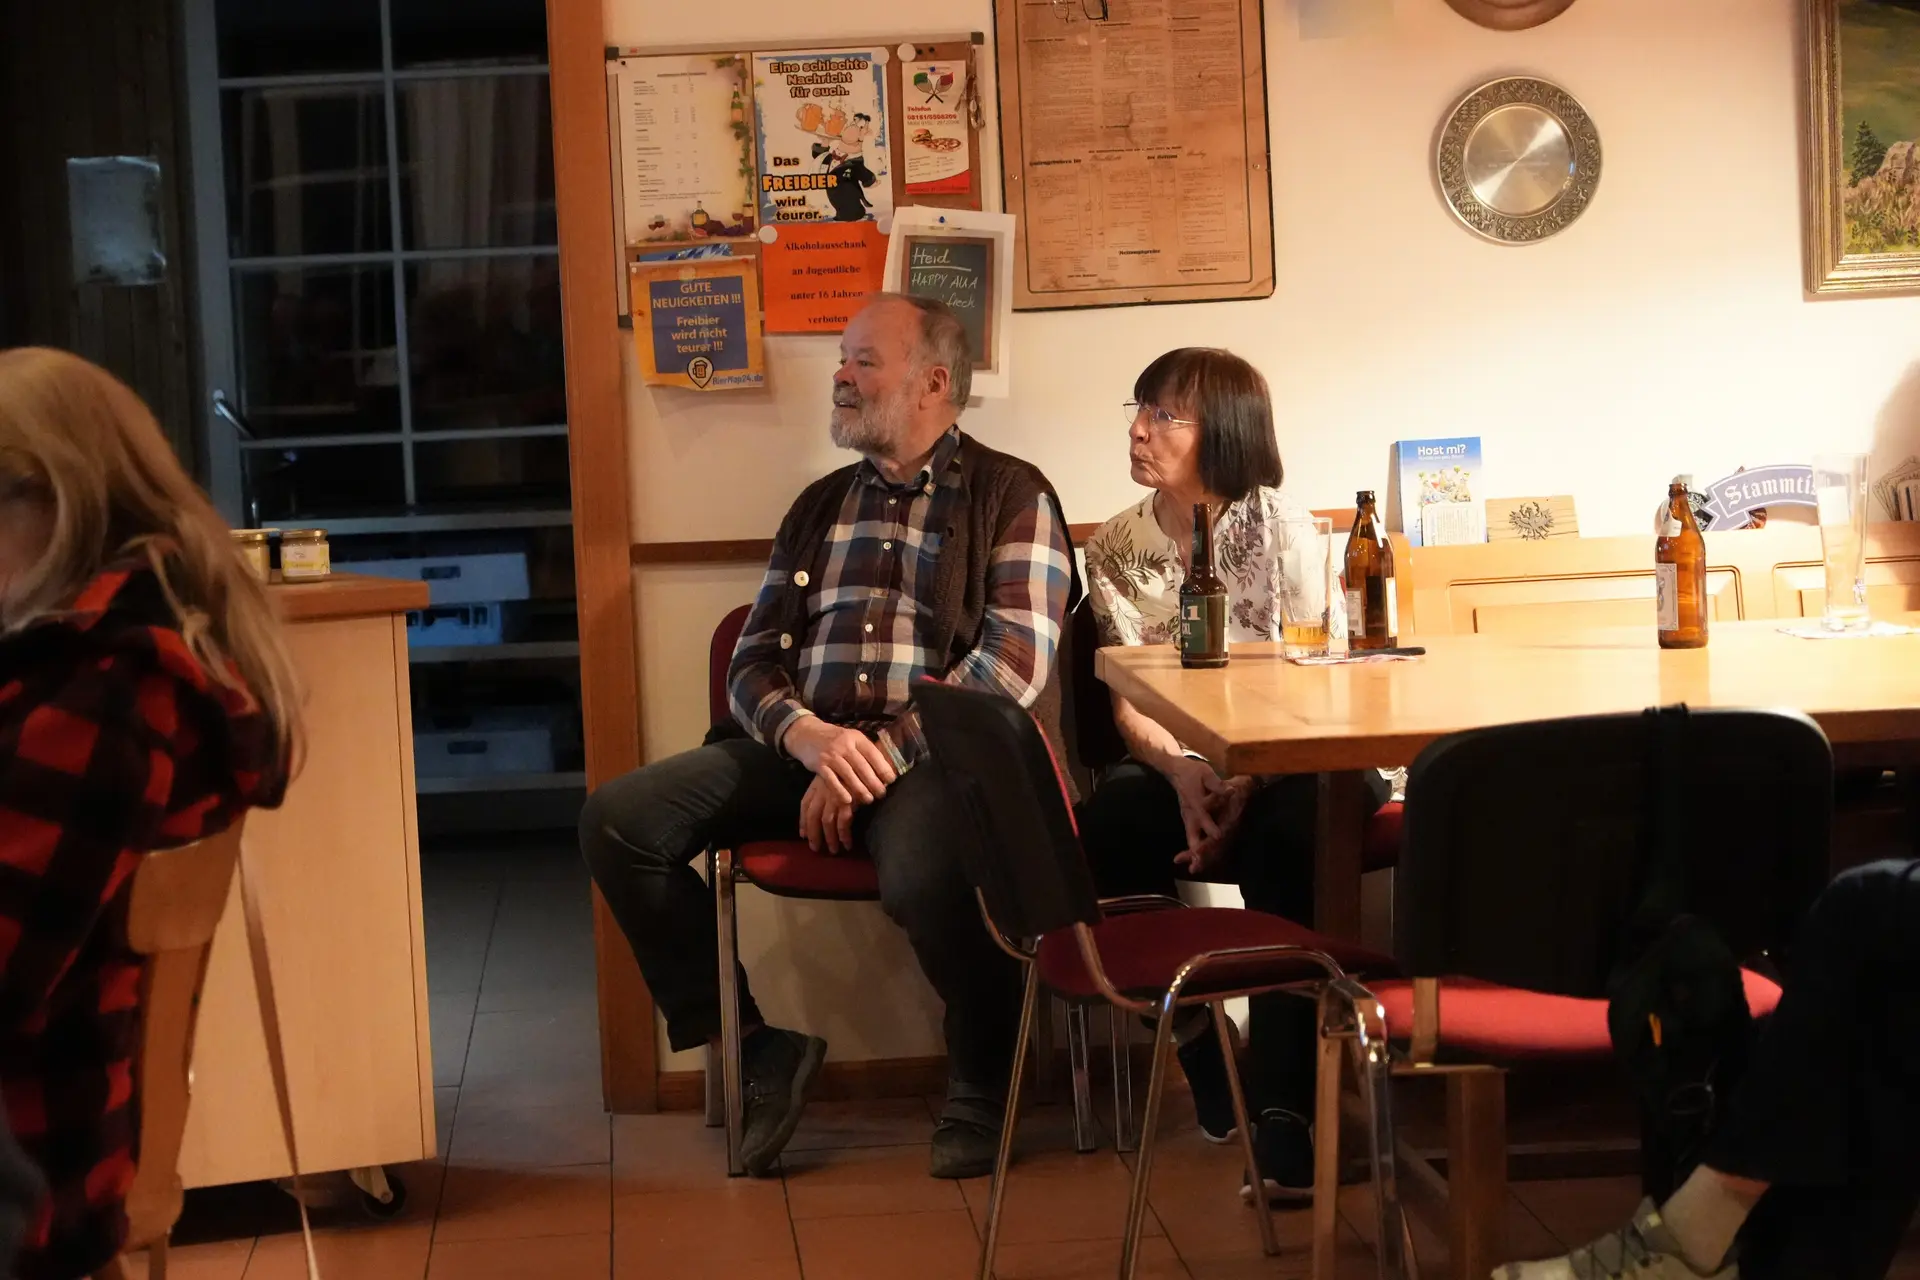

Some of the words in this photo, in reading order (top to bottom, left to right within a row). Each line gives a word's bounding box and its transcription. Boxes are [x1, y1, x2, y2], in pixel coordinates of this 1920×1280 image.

[769, 62, 800, 74] Eine
[802, 59, 869, 72] schlechte
[786, 73, 853, 86] Nachricht
[789, 87, 811, 98] für
[812, 85, 850, 97] euch.
[773, 156, 801, 167] Das
[762, 173, 838, 191] FREIBIER
[775, 196, 806, 207] wird
[776, 210, 822, 220] teurer.
[784, 240, 867, 251] Alkoholausschank
[792, 268, 803, 276] an
[806, 265, 862, 277] Jugendliche
[911, 272, 949, 288] HAPPY
[680, 281, 713, 294] GUTE
[790, 291, 816, 300] unter
[818, 290, 829, 299] 16
[831, 289, 864, 299] Jahren
[652, 294, 729, 309] NEUIGKEITEN
[676, 314, 720, 327] Freibier
[808, 315, 849, 325] verboten
[671, 329, 697, 341] wird
[698, 327, 728, 339] nicht
[676, 342, 711, 354] teurer
[1418, 445, 1444, 456] Host
[1446, 443, 1467, 455] mi?
